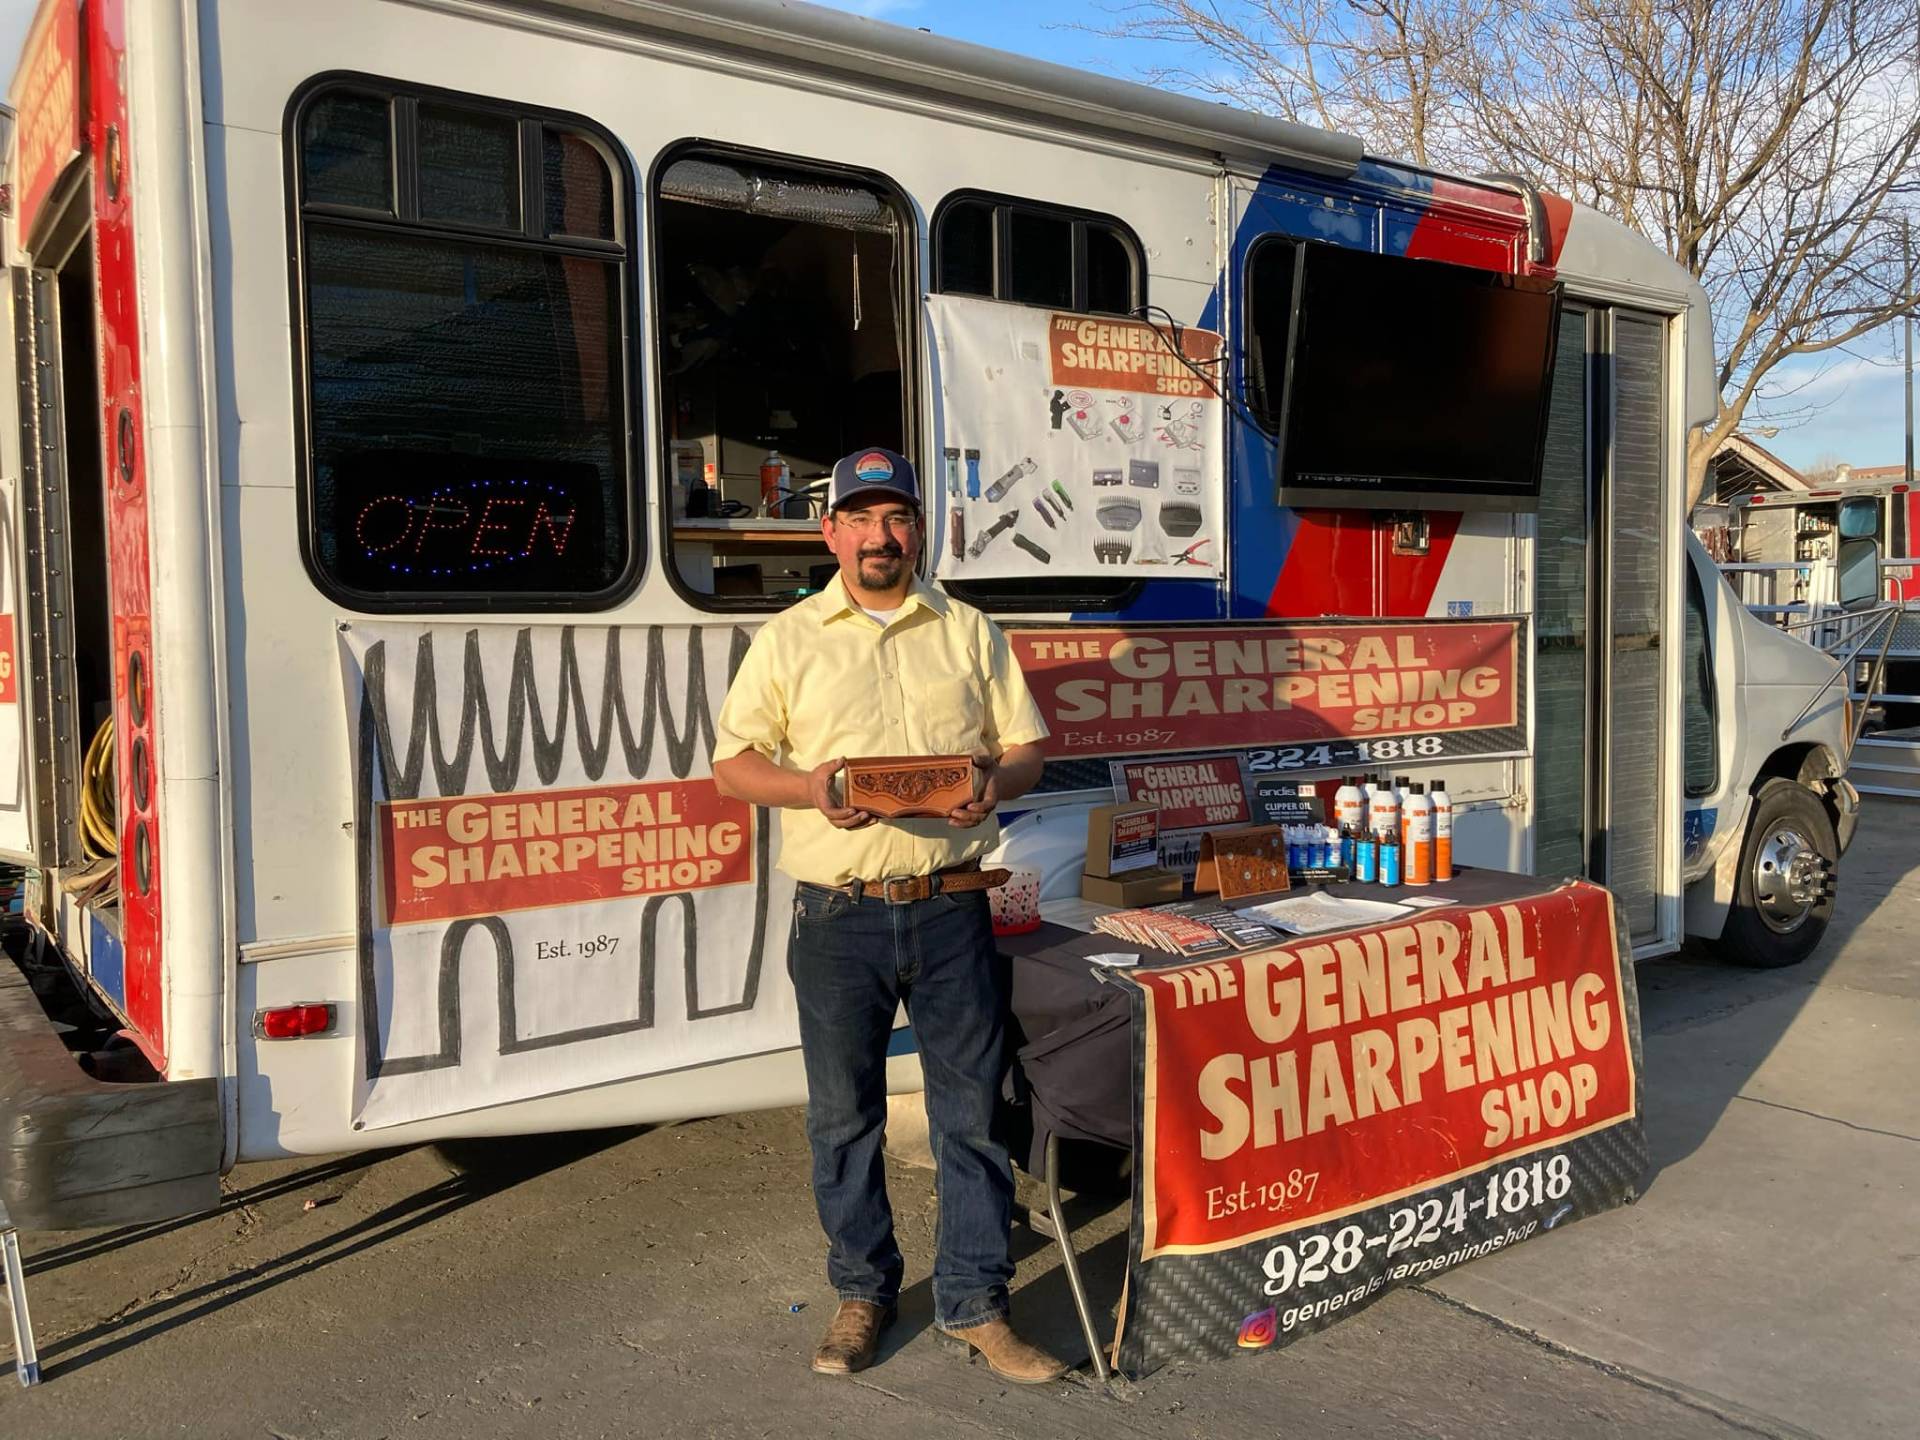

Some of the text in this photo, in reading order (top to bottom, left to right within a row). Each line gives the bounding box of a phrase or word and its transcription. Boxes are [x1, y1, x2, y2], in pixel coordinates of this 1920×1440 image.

[1056, 319, 1077, 331] THE
[1156, 377, 1204, 395] SHOP
[356, 495, 577, 556] OPEN
[1030, 634, 1430, 679] THE GENERAL
[1055, 666, 1501, 722] SHARPENING
[1350, 702, 1478, 733] SHOP
[1127, 764, 1219, 789] THE GENERAL
[1259, 786, 1296, 796] andis
[393, 791, 681, 844] THE GENERAL
[1205, 806, 1239, 822] SHOP
[1264, 802, 1312, 811] CLIPPER OIL
[410, 822, 742, 889] SHARPENING
[621, 859, 724, 892] SHOP
[536, 934, 620, 960] Est. 1987
[1158, 961, 1238, 1010] THE
[1243, 904, 1537, 1044] GENERAL
[1197, 973, 1611, 1161] SHARPENING
[1480, 1063, 1599, 1149] SHOP
[1262, 1154, 1572, 1296] 928-224-1818
